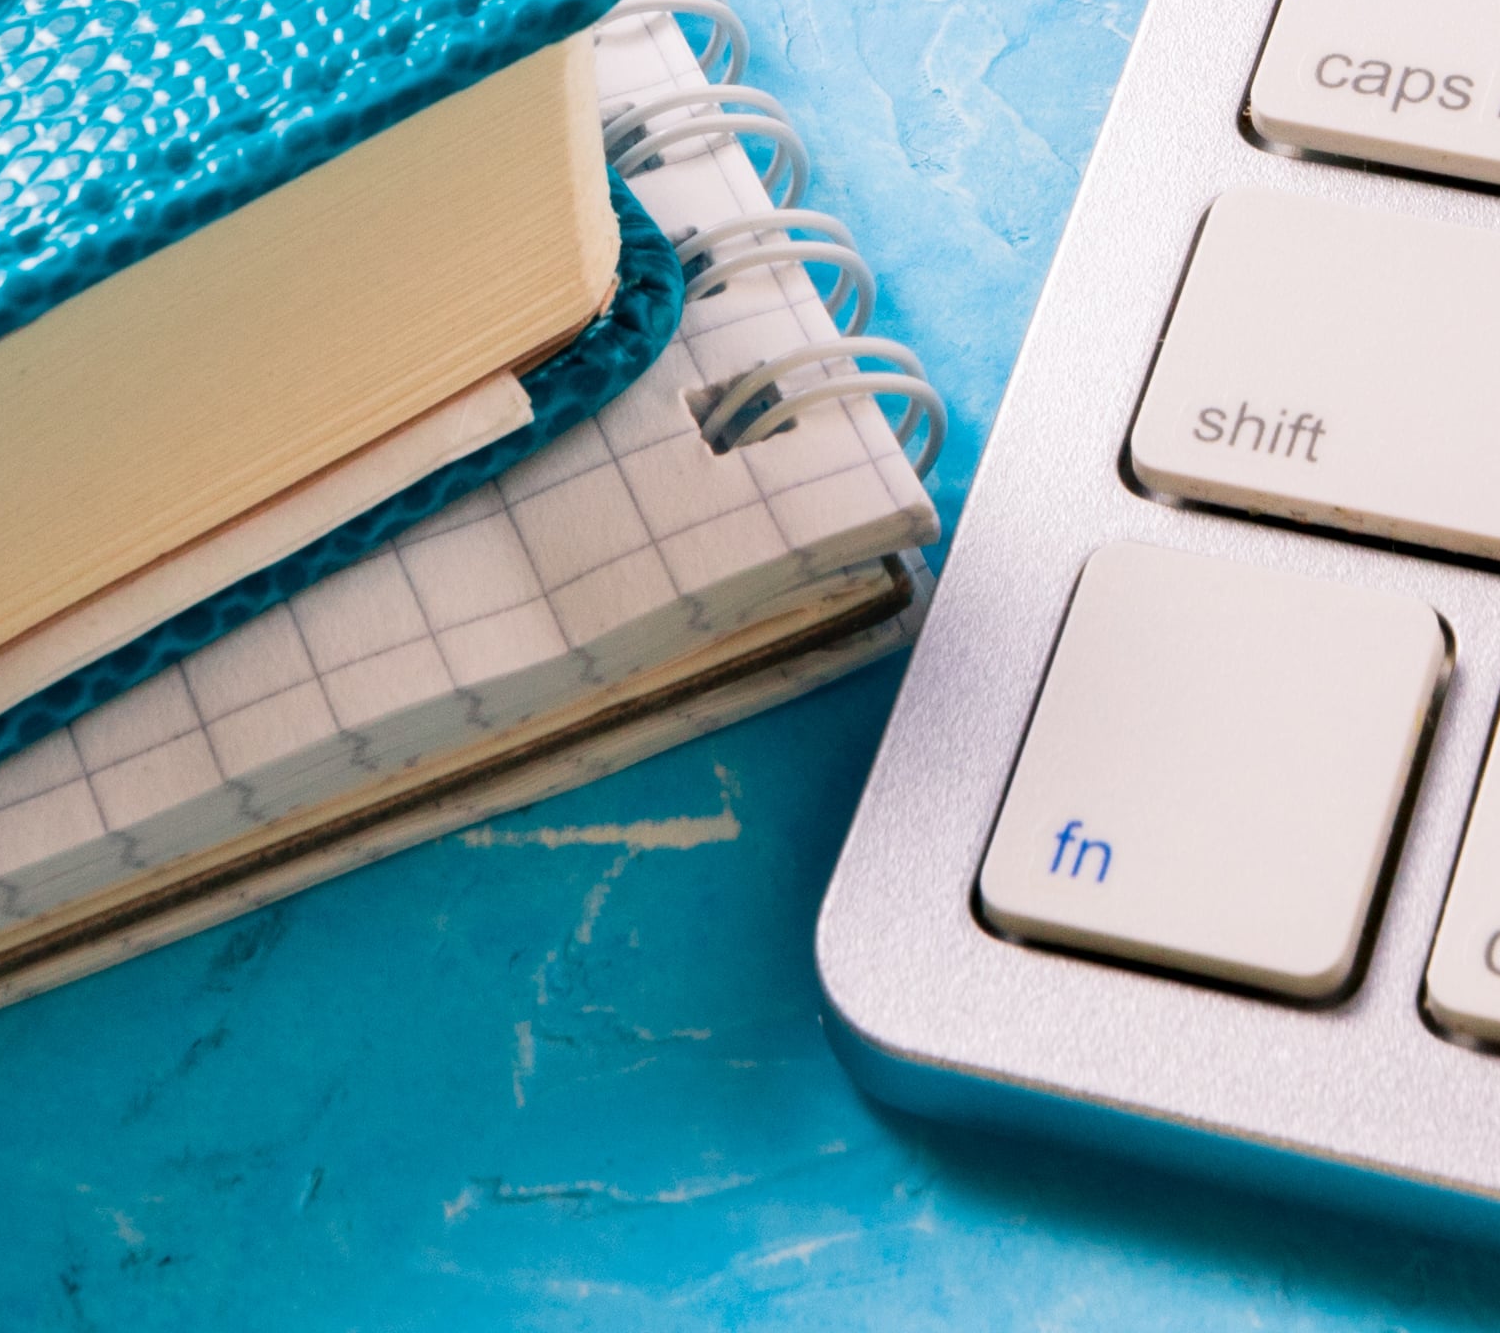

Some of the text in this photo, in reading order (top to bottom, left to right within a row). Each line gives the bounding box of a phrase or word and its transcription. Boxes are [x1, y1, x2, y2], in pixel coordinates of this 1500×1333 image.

[1314, 53, 1475, 113] caps
[1193, 401, 1326, 463] shift
[1050, 820, 1112, 883] fn
